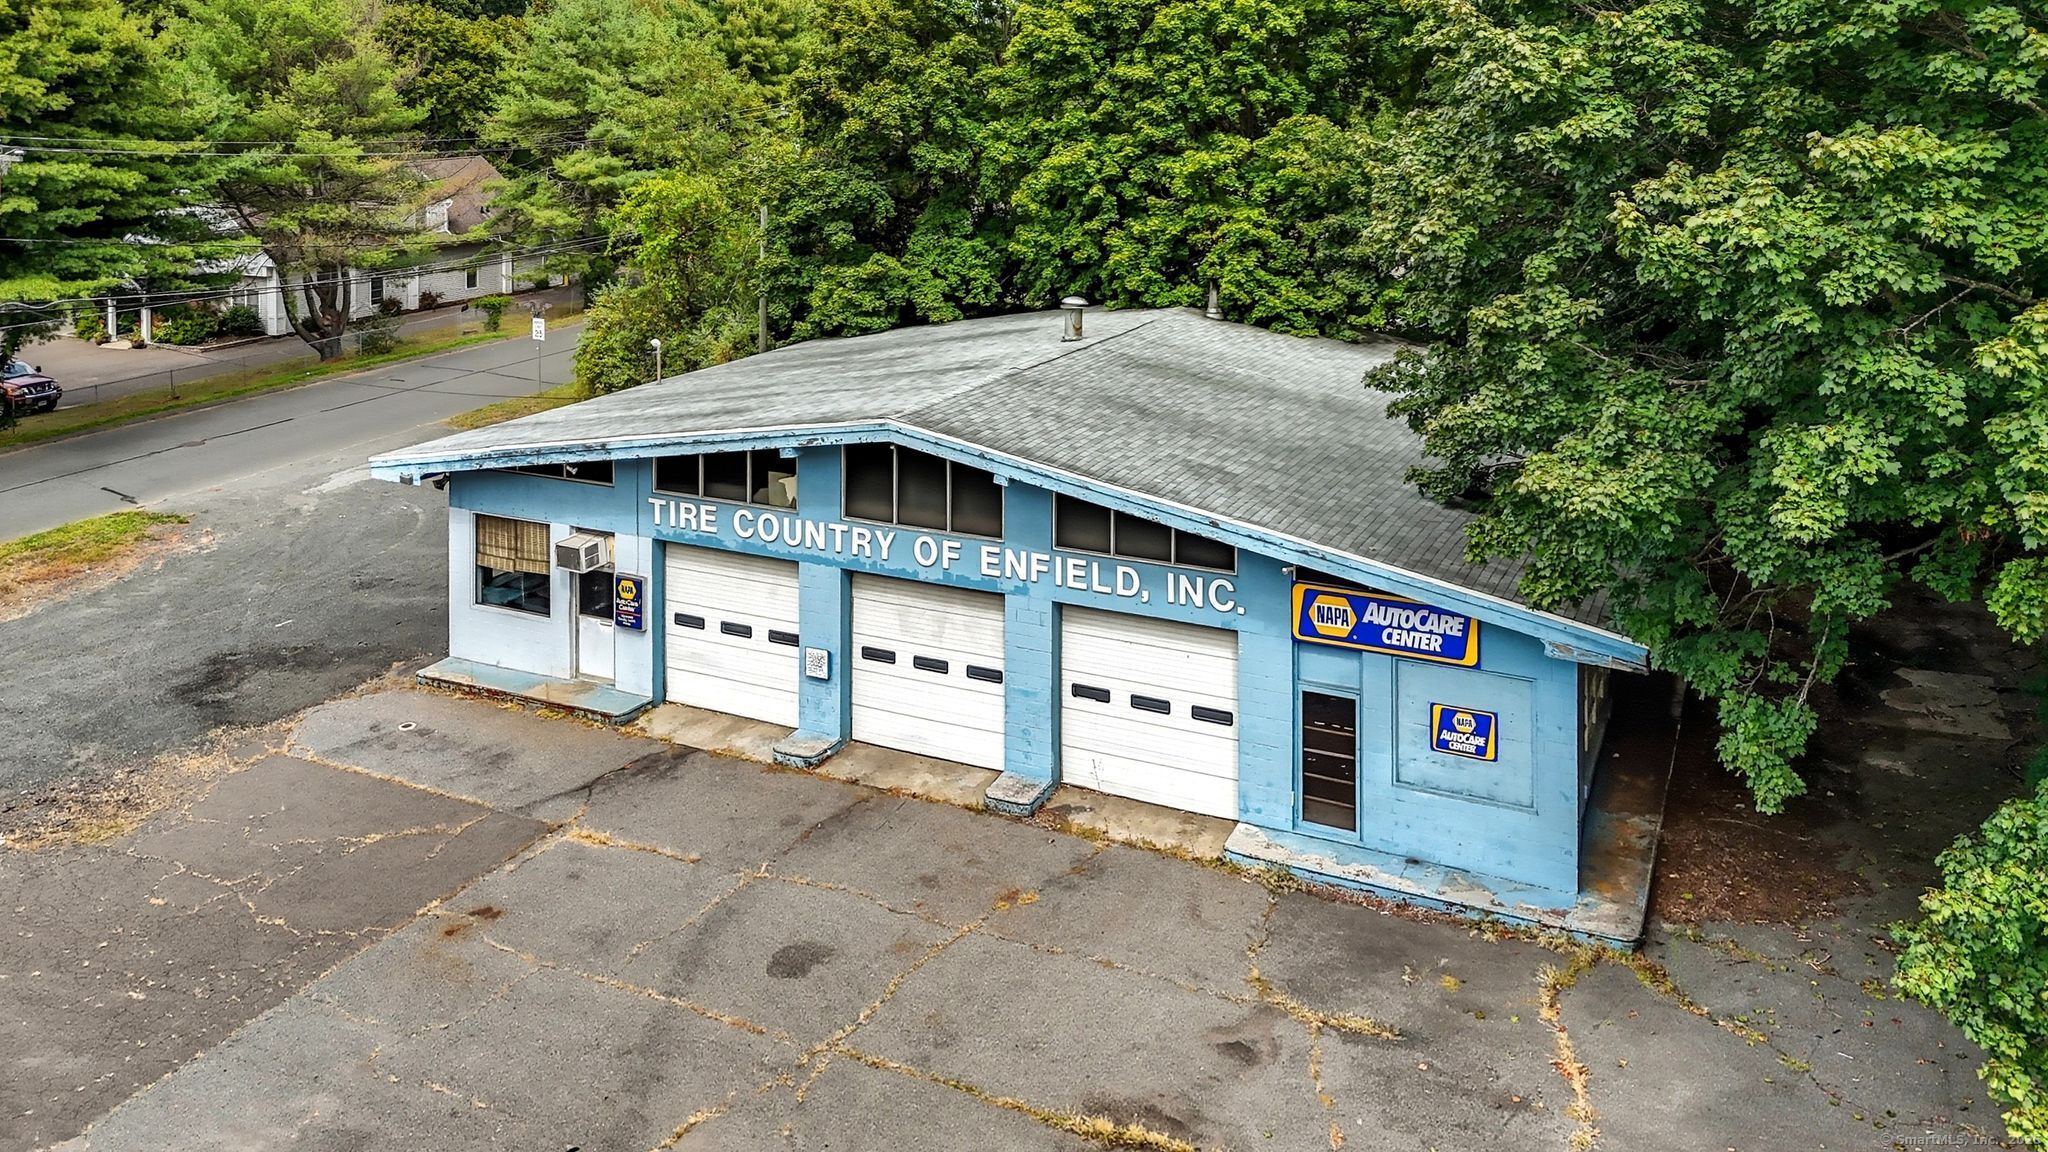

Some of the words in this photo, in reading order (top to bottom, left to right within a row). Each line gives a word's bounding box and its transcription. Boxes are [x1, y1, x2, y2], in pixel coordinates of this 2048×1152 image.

[648, 497, 718, 534] TIRE
[732, 509, 896, 561] COUNTRY
[913, 535, 962, 569] OF
[980, 545, 1151, 603] ENFIELD,
[1166, 572, 1246, 615] INC.
[1316, 604, 1350, 627] NAPA
[1381, 627, 1443, 652] CENTER
[1456, 717, 1473, 728] NAPA
[1448, 741, 1477, 753] CENTER
